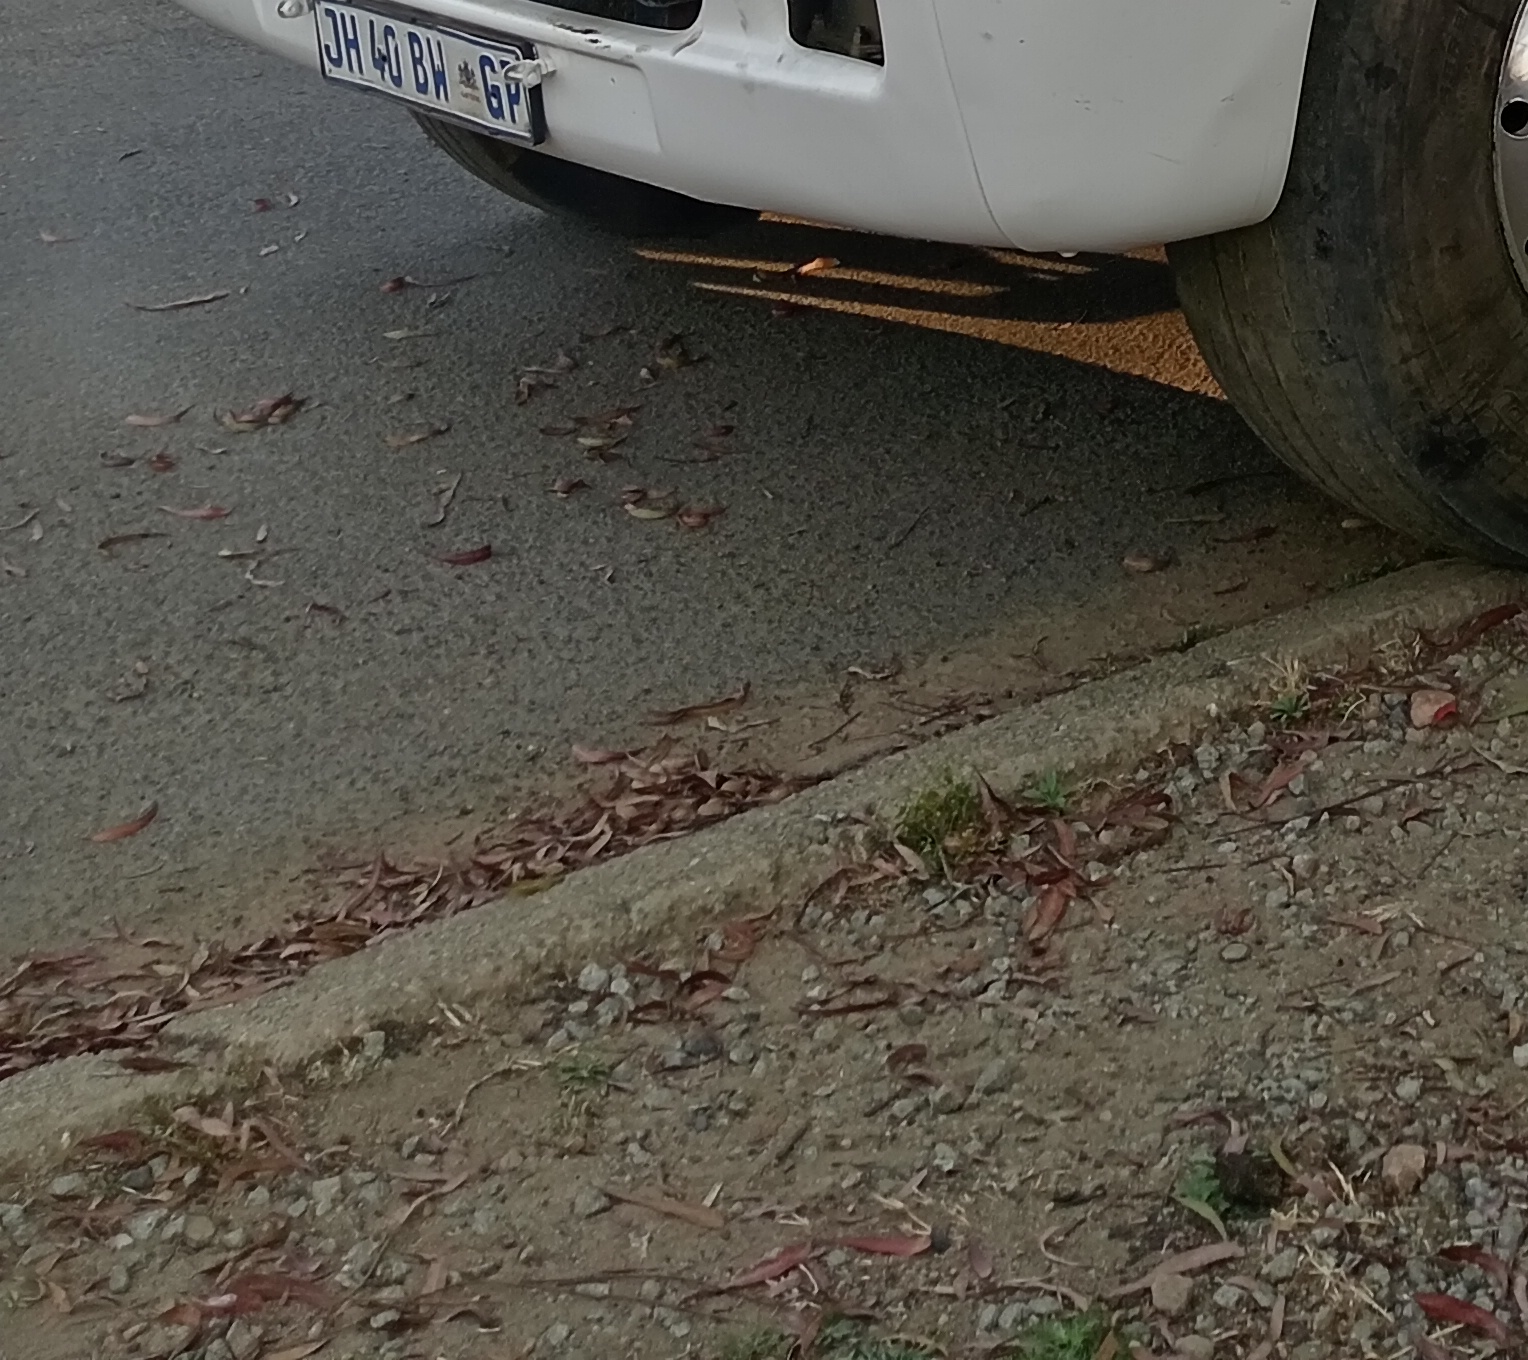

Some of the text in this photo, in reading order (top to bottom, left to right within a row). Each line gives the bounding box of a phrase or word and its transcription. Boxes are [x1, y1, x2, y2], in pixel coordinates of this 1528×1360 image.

[324, 7, 364, 76] JH
[368, 18, 403, 88] 40
[478, 54, 521, 124] GP
